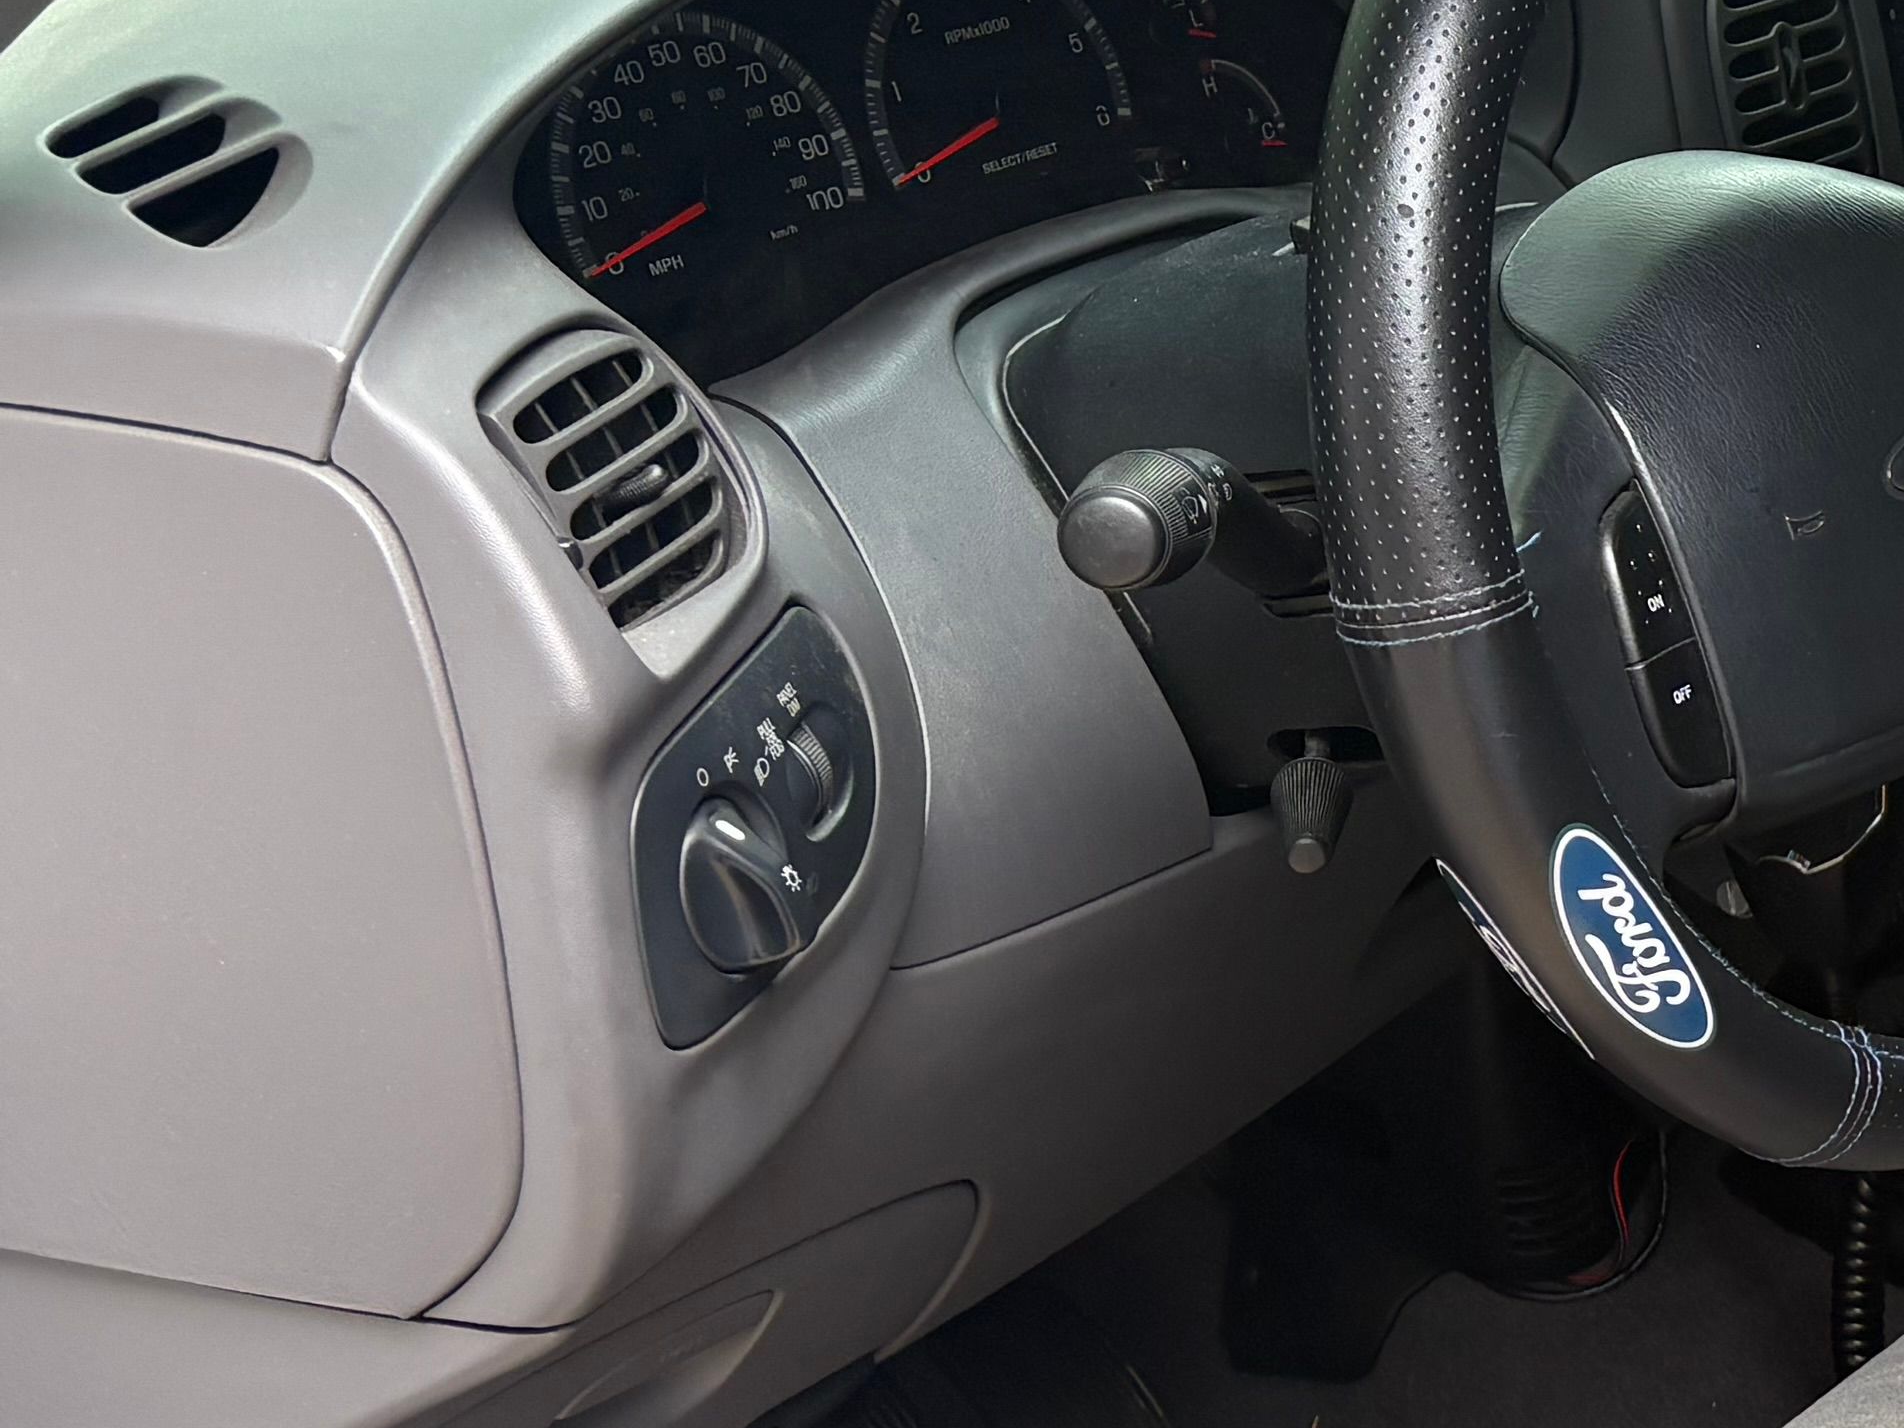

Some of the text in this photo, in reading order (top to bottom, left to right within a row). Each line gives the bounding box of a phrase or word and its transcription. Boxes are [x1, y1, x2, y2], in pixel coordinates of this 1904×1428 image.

[907, 11, 924, 35] 2
[648, 40, 681, 68] 50
[693, 41, 726, 68] 60
[1068, 31, 1084, 55] 5
[613, 60, 644, 86] 40
[736, 62, 767, 89] 70
[770, 90, 801, 117] 80
[890, 80, 902, 102] 1
[588, 95, 621, 123] 30
[1095, 104, 1111, 128] 6
[579, 141, 611, 169] 20
[798, 134, 830, 161] 90
[981, 140, 1059, 175] SELECT/RESET
[582, 195, 609, 222] 10
[806, 186, 844, 211] 100
[770, 224, 798, 241] km/h
[605, 252, 624, 275] 0
[648, 255, 684, 278] MPH
[1646, 592, 1666, 613] ON
[1672, 683, 1693, 705] OFF
[1577, 873, 1692, 1014] Ford
